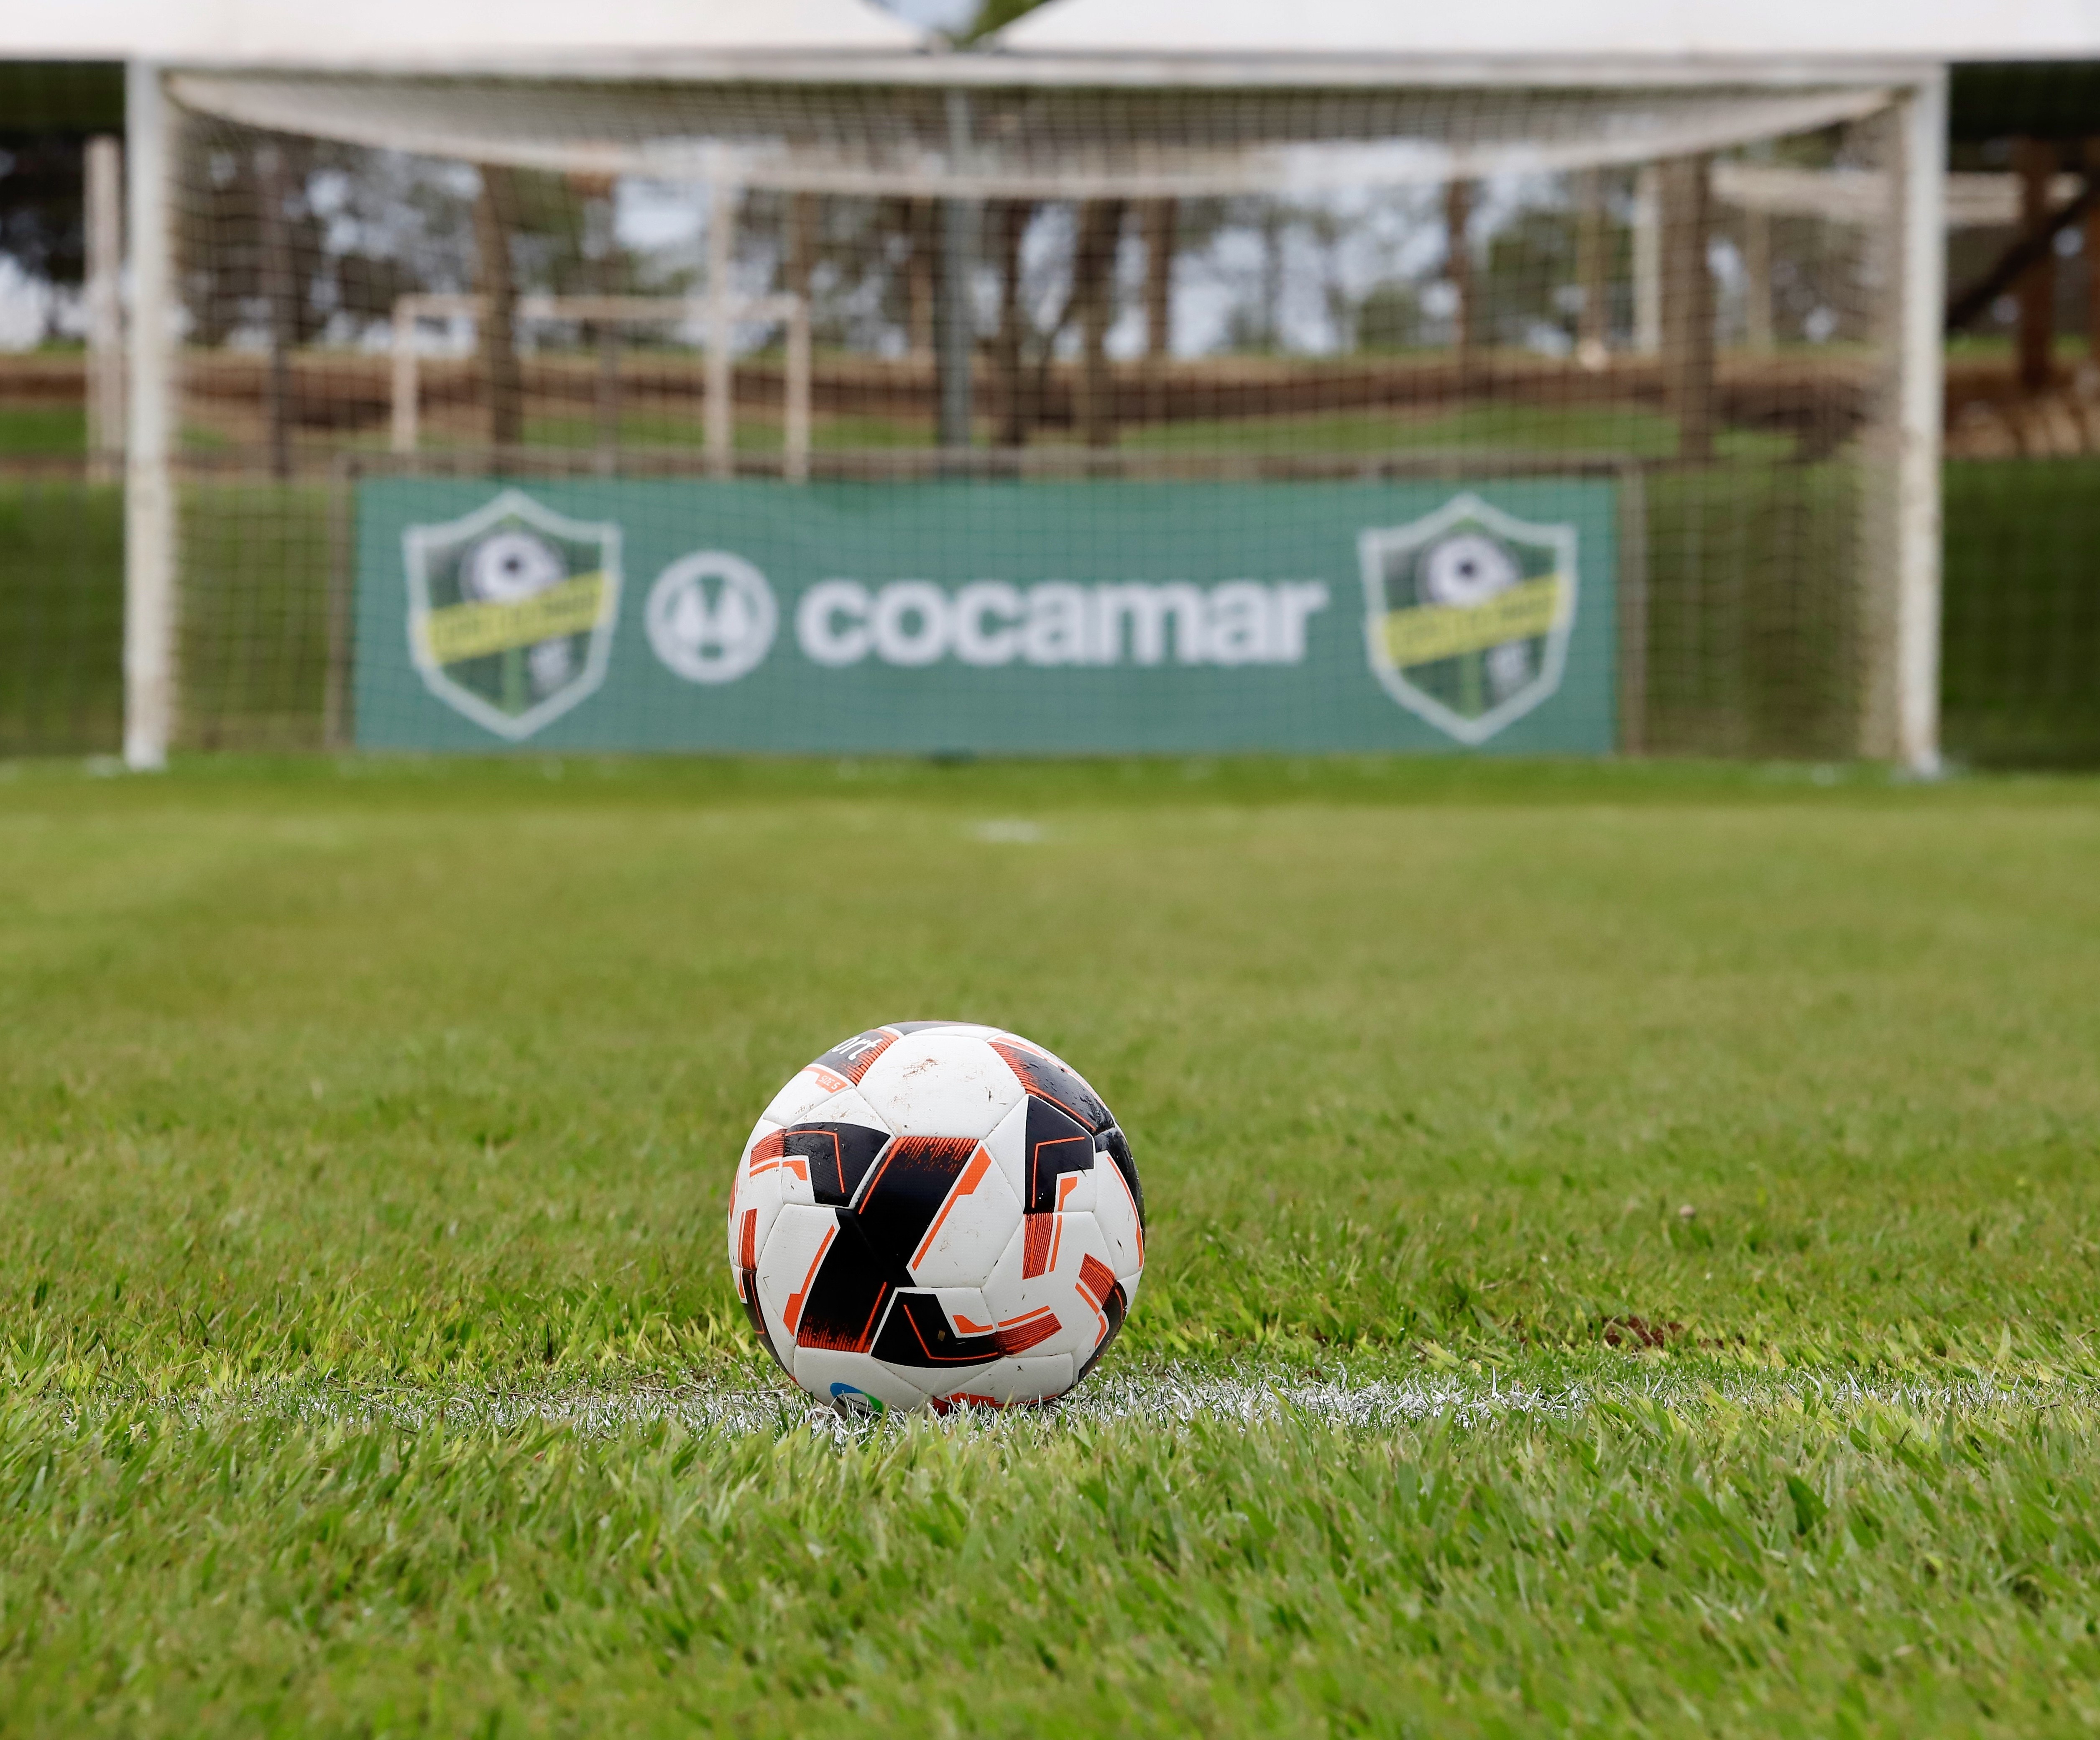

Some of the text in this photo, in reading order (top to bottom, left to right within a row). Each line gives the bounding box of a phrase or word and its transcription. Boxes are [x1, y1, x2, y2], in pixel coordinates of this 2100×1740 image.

[797, 581, 1328, 664] cocamar
[828, 1036, 883, 1061] ort
[818, 1075, 841, 1090] SIZE 5
